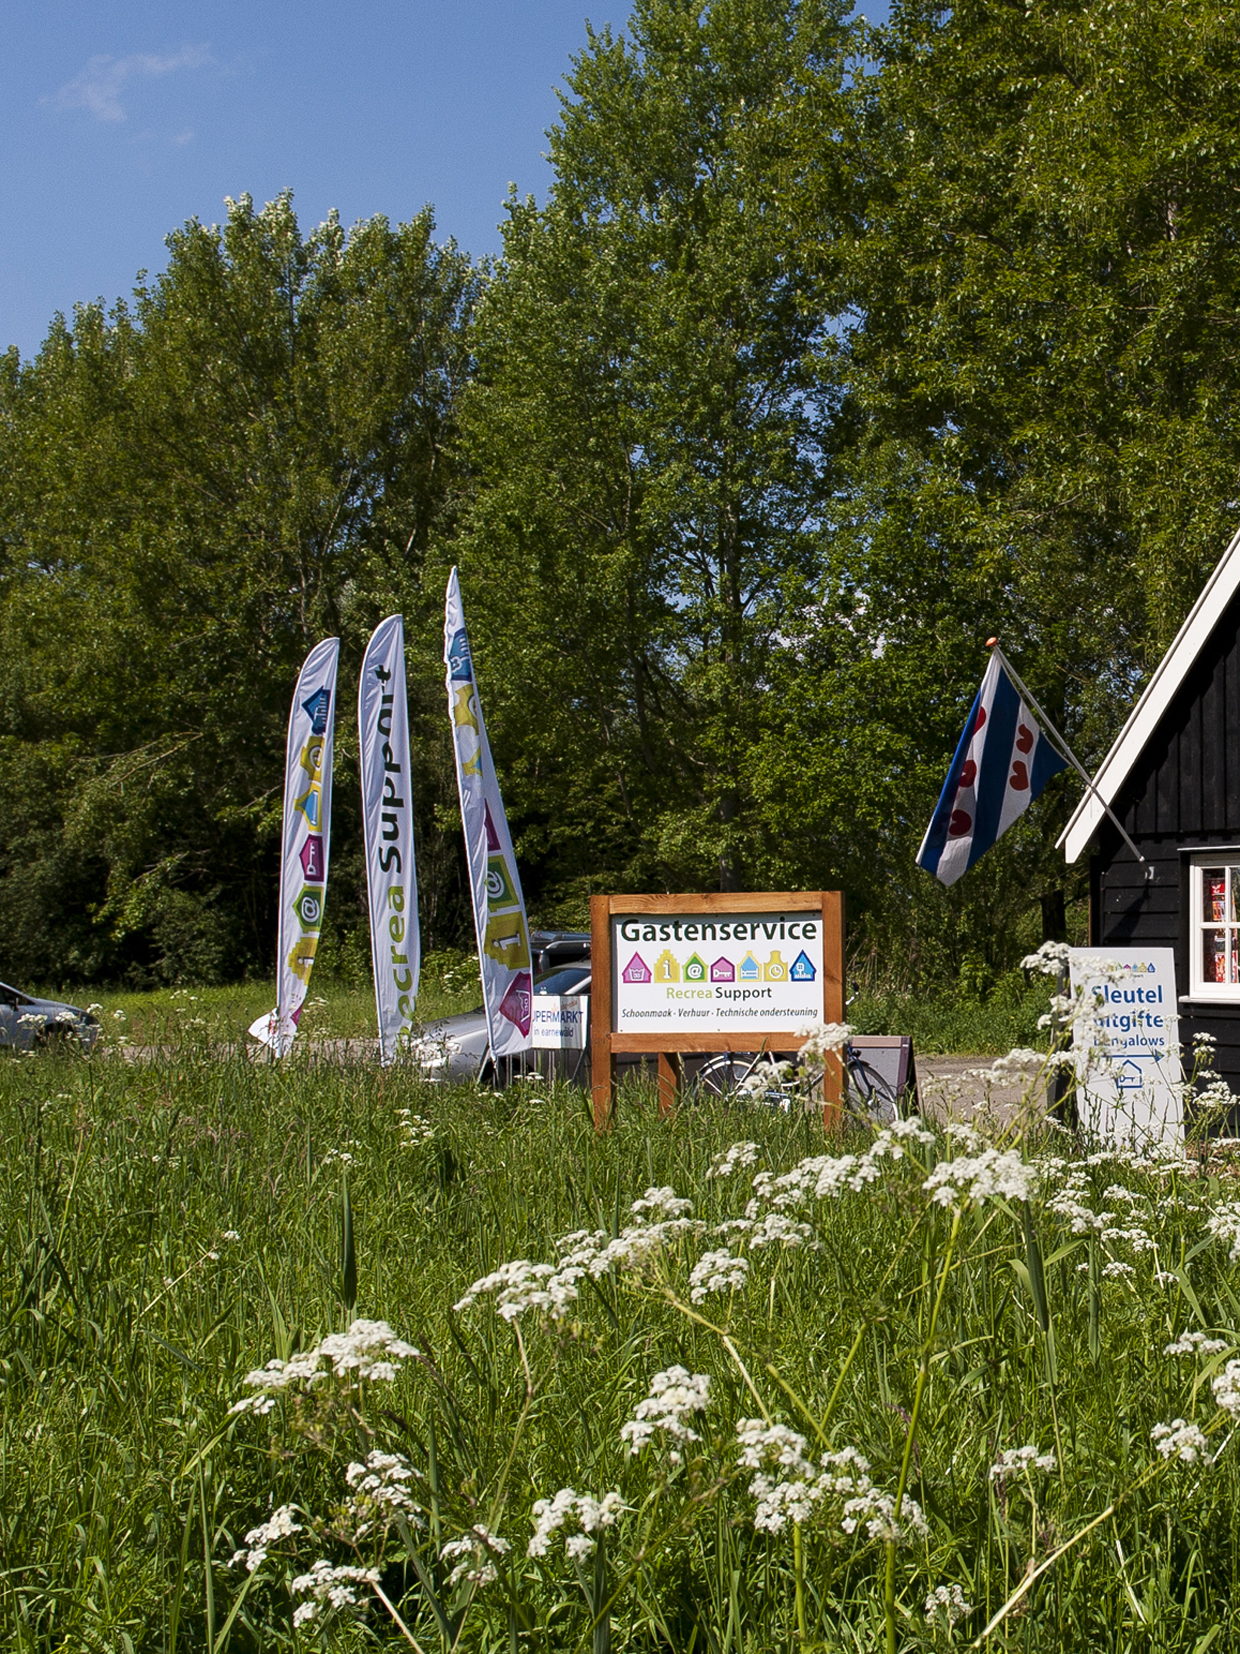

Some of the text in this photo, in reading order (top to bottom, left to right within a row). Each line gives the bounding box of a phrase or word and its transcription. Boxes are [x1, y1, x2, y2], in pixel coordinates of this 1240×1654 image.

[374, 663, 405, 875] Support
[620, 916, 818, 942] Gastenservice
[666, 986, 772, 1001] Recrea Support
[1091, 984, 1163, 1004] Sleutel
[621, 1008, 672, 1018] Schoonmaak
[678, 1008, 710, 1017] Verhuur
[715, 1007, 759, 1017] Technische
[759, 1006, 819, 1019] ondersteuning
[534, 1027, 540, 1036] in
